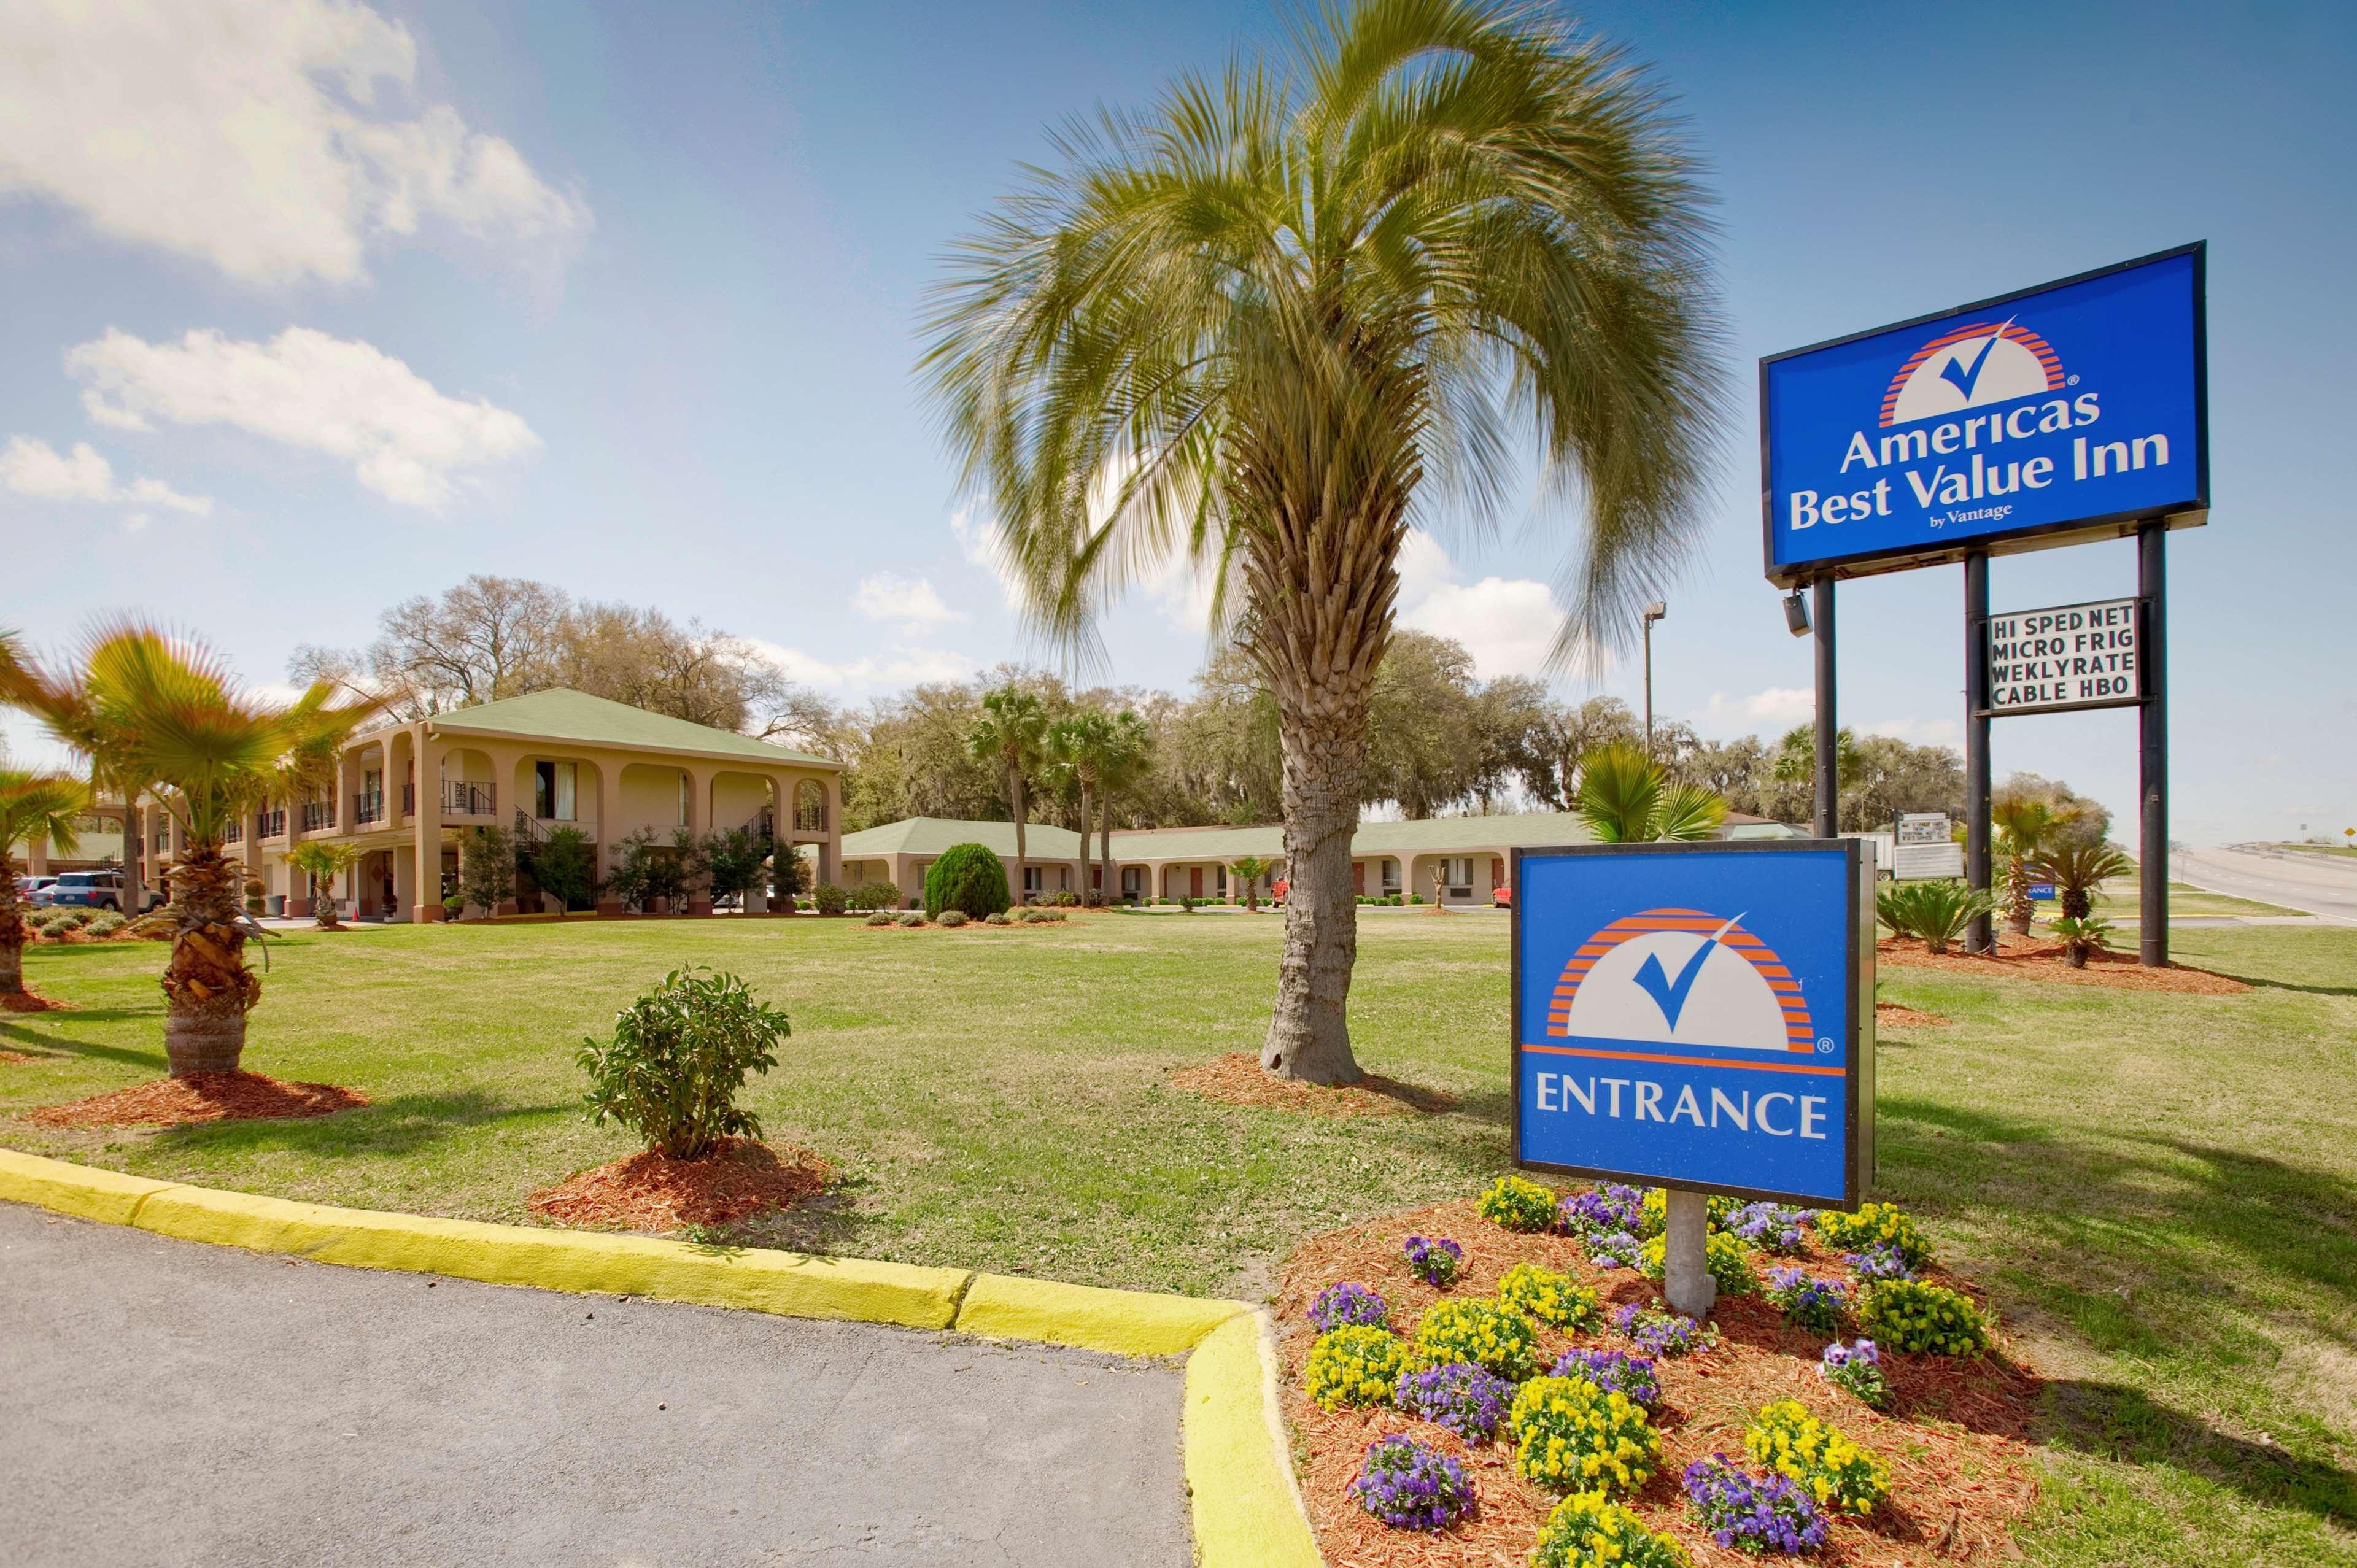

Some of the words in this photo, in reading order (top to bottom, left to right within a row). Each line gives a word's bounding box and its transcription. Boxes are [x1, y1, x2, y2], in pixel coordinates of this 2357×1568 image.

[1840, 392, 2100, 473] Americas
[1790, 479, 1892, 530] Best
[1905, 454, 2054, 509] Value
[2074, 433, 2169, 481] Inn
[1930, 517, 1945, 529] by
[1946, 505, 2013, 523] Vantage
[1995, 620, 2016, 639] HI
[2026, 612, 2082, 635] SPED
[2089, 605, 2132, 628] NET
[1993, 638, 2065, 661] MICRO
[2075, 629, 2132, 652] FRIG
[1994, 682, 2066, 705] CABLE
[2080, 676, 2127, 697] HBO
[1536, 1072, 1827, 1140] ENTRANCE
